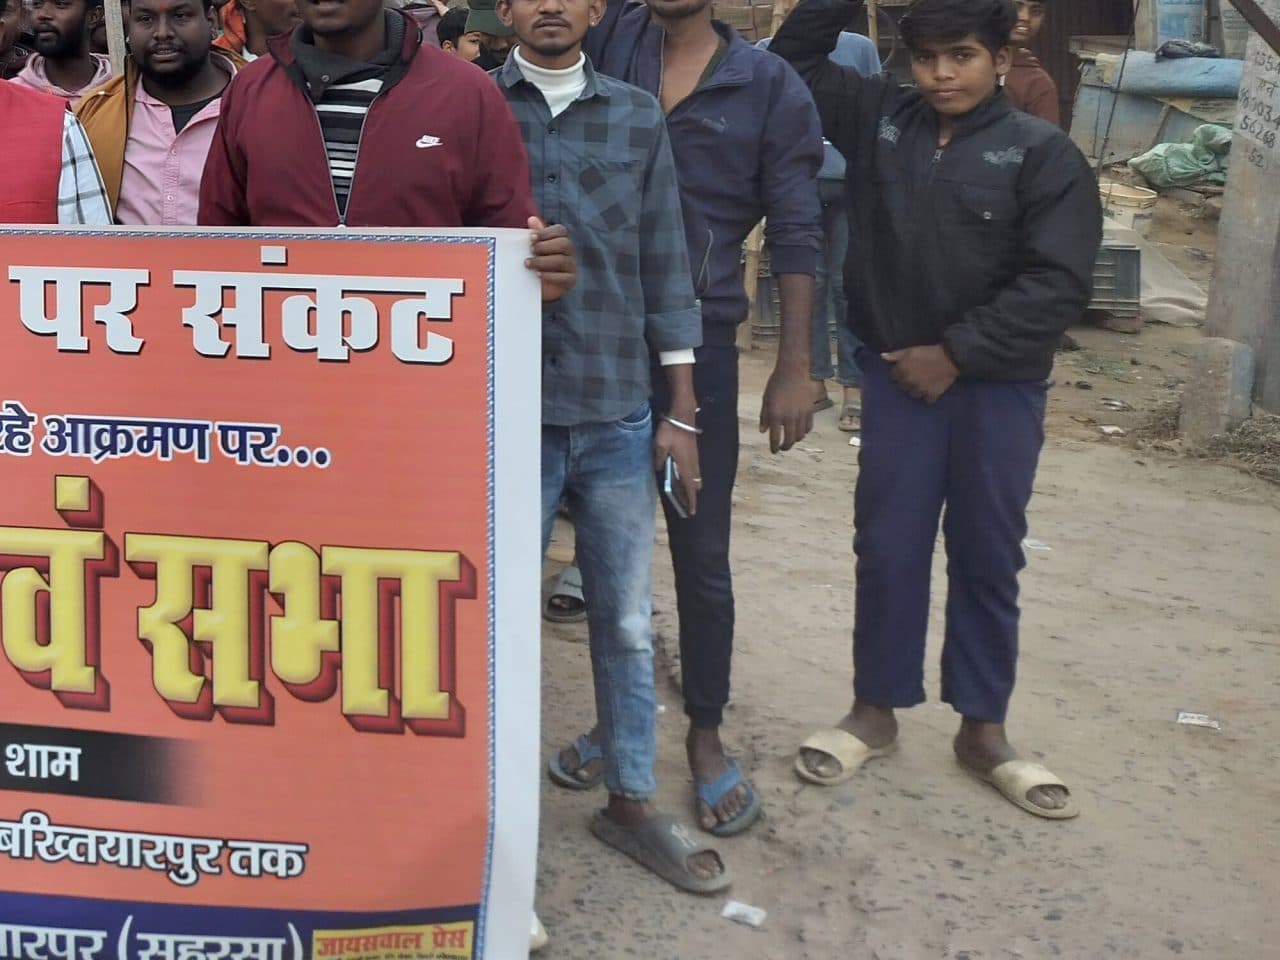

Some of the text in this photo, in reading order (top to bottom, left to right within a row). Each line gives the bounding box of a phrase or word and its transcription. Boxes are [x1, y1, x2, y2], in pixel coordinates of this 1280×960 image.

[8, 265, 150, 354] पर
[172, 245, 465, 365] संकट
[42, 414, 211, 464] आक्रमण
[124, 533, 469, 729] सभा
[5, 743, 82, 781] शाम
[228, 841, 307, 878] तक
